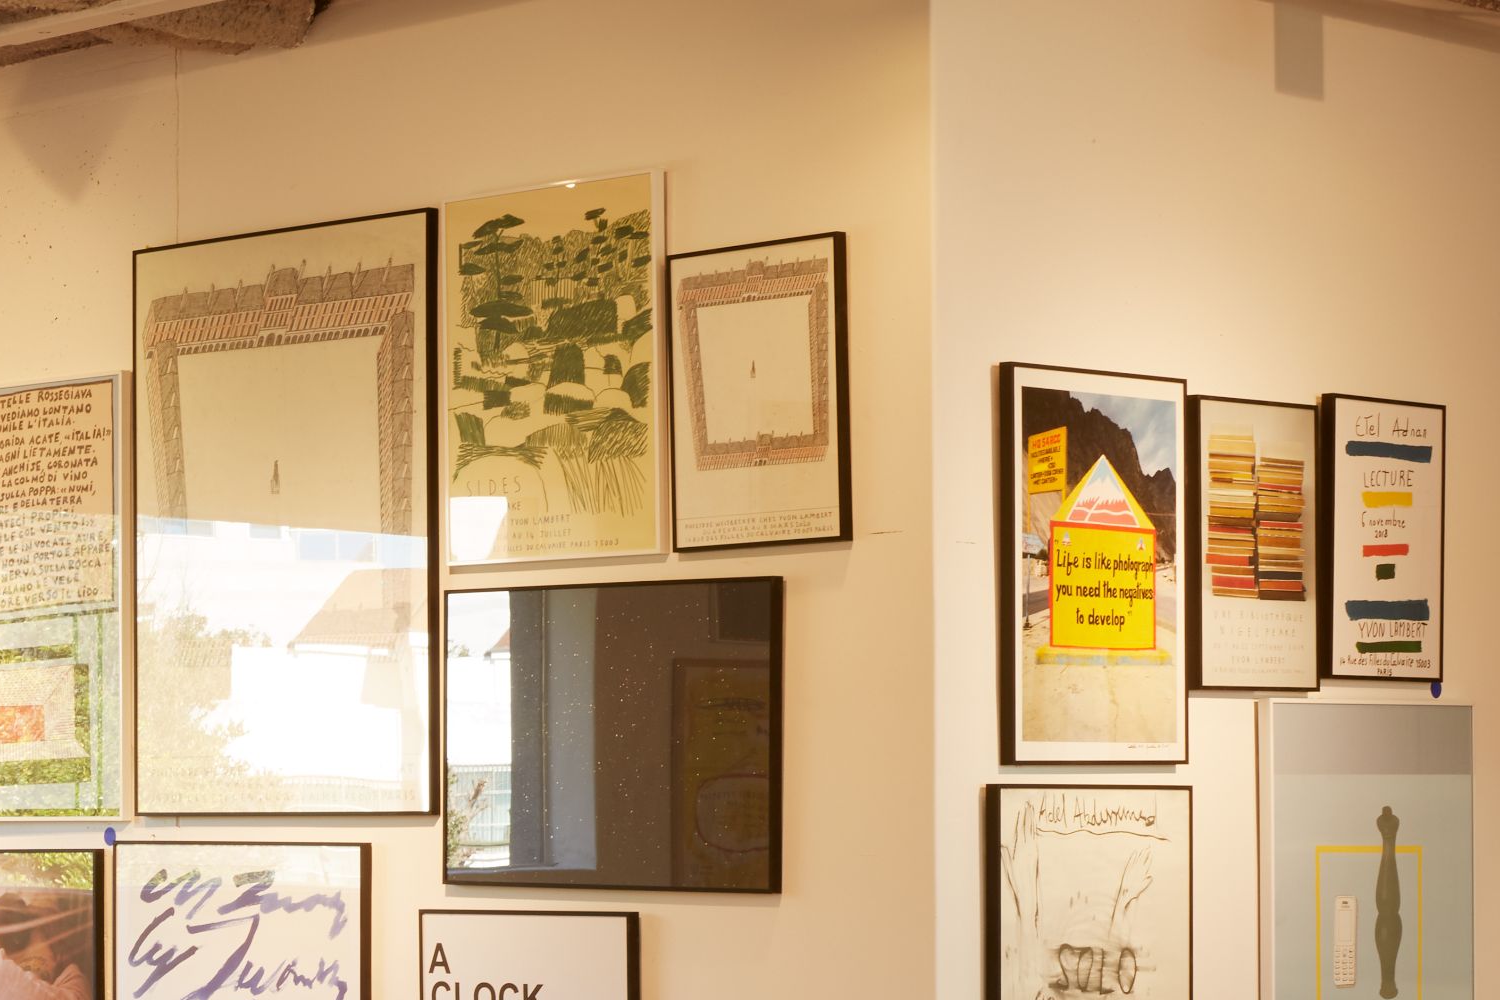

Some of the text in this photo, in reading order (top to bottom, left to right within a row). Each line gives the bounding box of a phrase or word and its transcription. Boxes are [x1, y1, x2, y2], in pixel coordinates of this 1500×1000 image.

[466, 475, 522, 497] SIDES
[1363, 470, 1414, 488] LECTURE
[1082, 552, 1091, 568] is
[1094, 552, 1111, 569] like
[1056, 580, 1153, 607] you need the negatives
[1076, 608, 1084, 624] to
[1359, 622, 1428, 638] YVON LAMBERT
[428, 942, 451, 974] A
